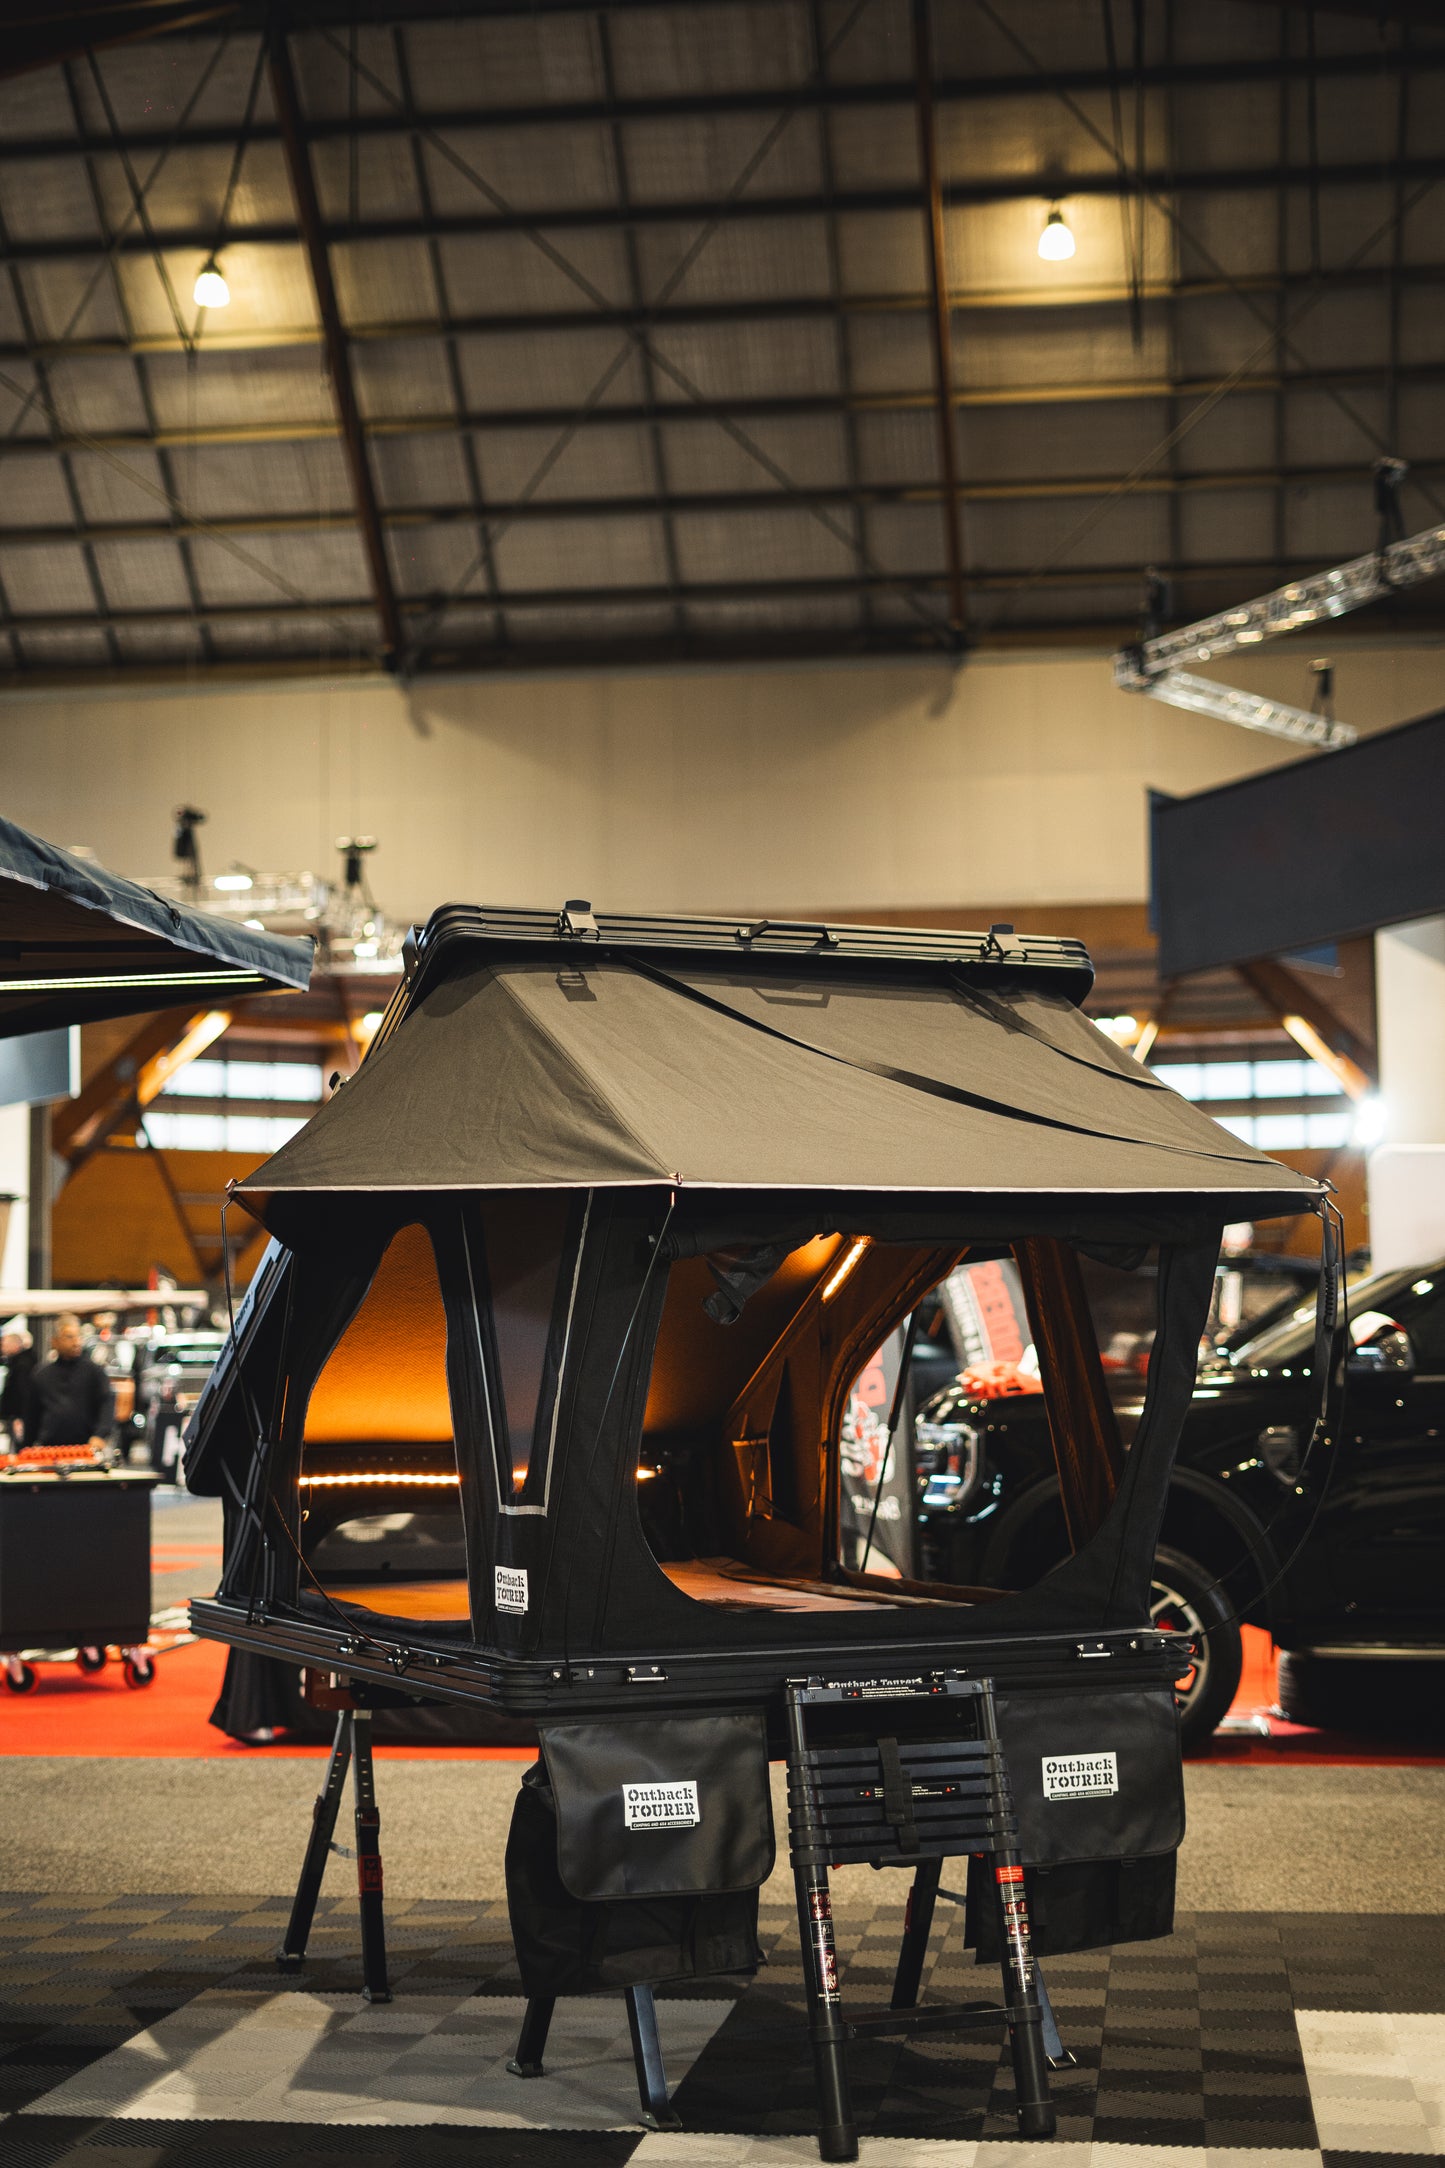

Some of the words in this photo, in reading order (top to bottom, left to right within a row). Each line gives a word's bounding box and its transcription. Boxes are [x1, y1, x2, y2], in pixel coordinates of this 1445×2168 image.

[497, 1571, 525, 1588] Outback
[497, 1586, 525, 1604] TOURER
[1046, 1758, 1113, 1774] Outback
[1047, 1772, 1114, 1789] TOURER
[628, 1787, 694, 1802] Outback
[629, 1802, 695, 1818] TOURER
